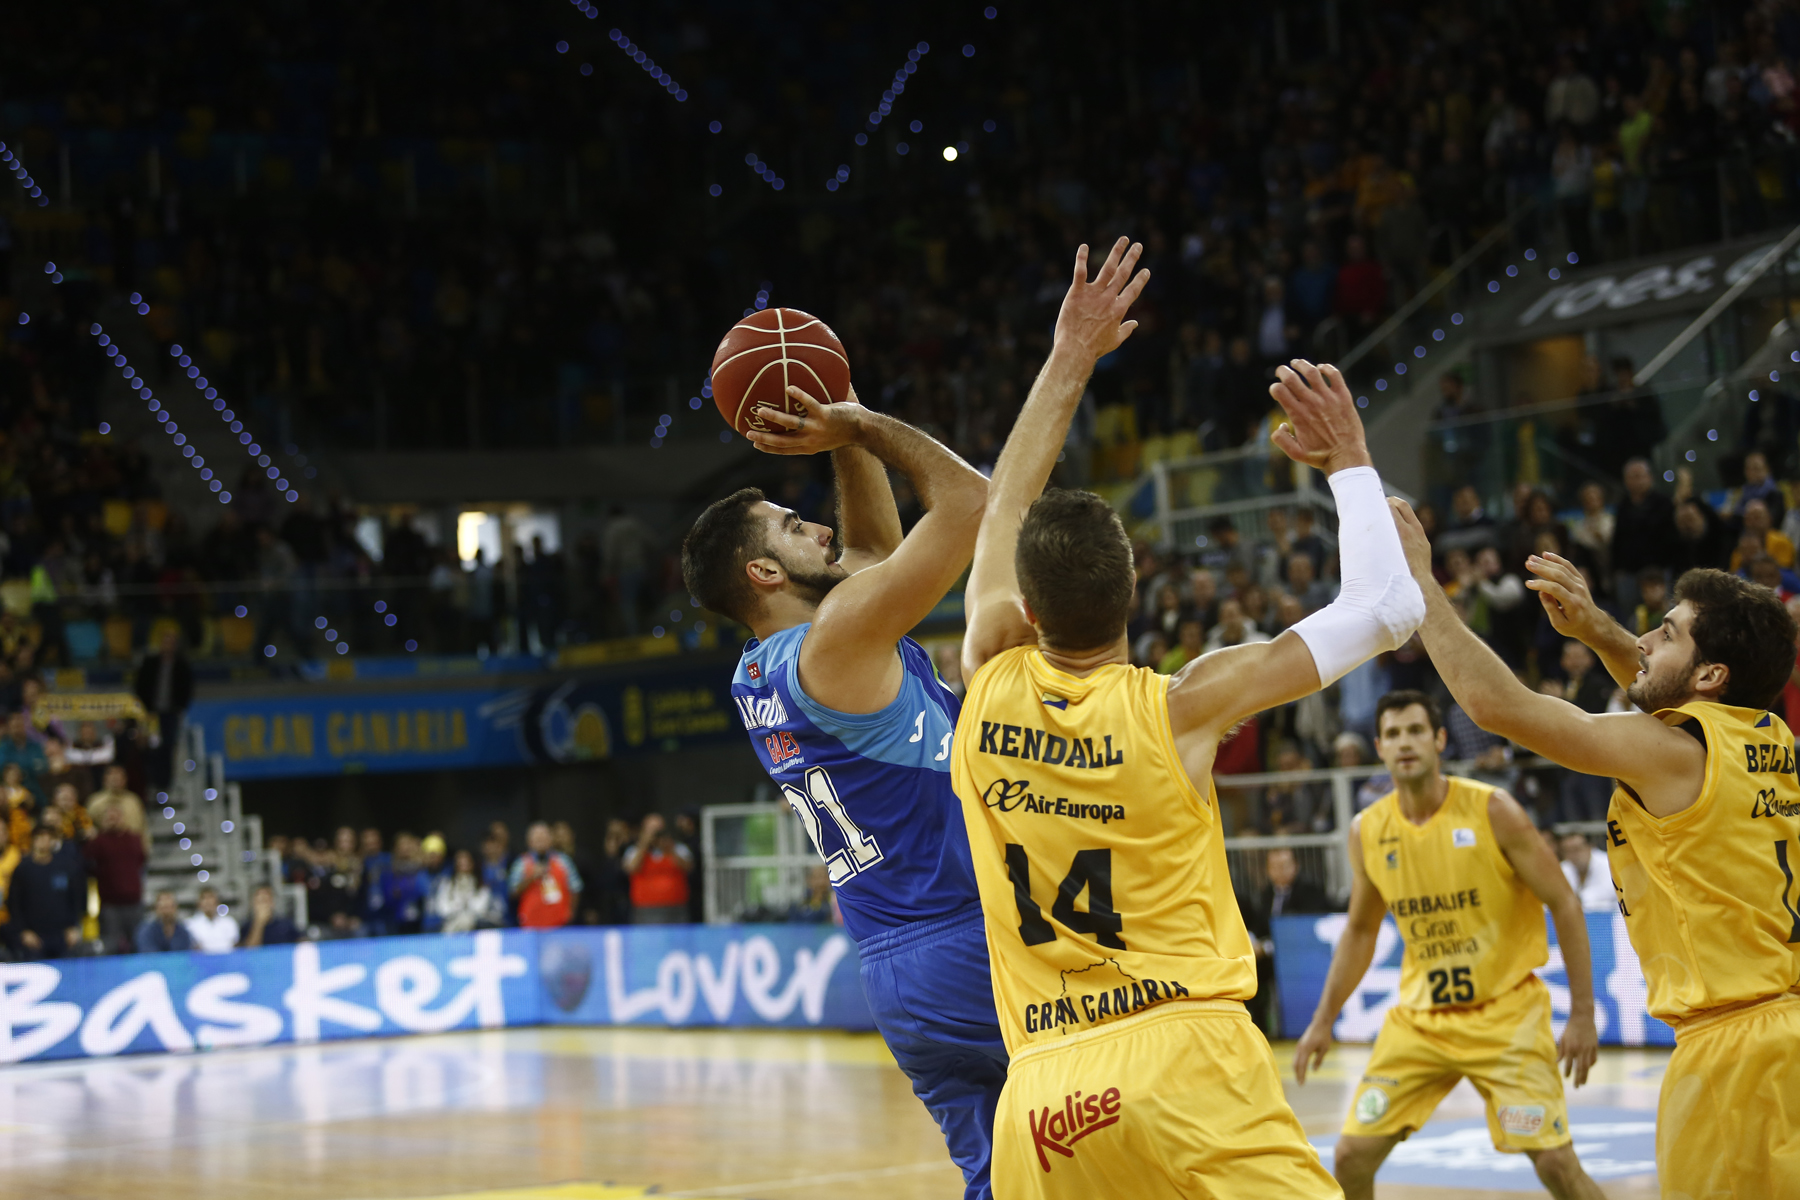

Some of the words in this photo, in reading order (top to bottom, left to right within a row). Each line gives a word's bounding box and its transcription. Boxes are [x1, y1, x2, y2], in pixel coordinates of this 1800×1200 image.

[224, 713, 313, 760] GRAN
[327, 708, 468, 758] CANARIA
[766, 731, 800, 764] GAES
[979, 721, 1123, 769] KENDALL
[781, 766, 885, 887] 21
[1024, 793, 1125, 824] AirEuropa
[1005, 843, 1127, 951] 14
[1410, 917, 1459, 940] Gran
[0, 929, 527, 1063] Basket
[604, 929, 849, 1025] Lover
[1026, 995, 1079, 1034] GRAN
[1081, 979, 1189, 1023] CANARIA
[1428, 967, 1474, 1003] 25
[1028, 1086, 1121, 1173] Kalise
